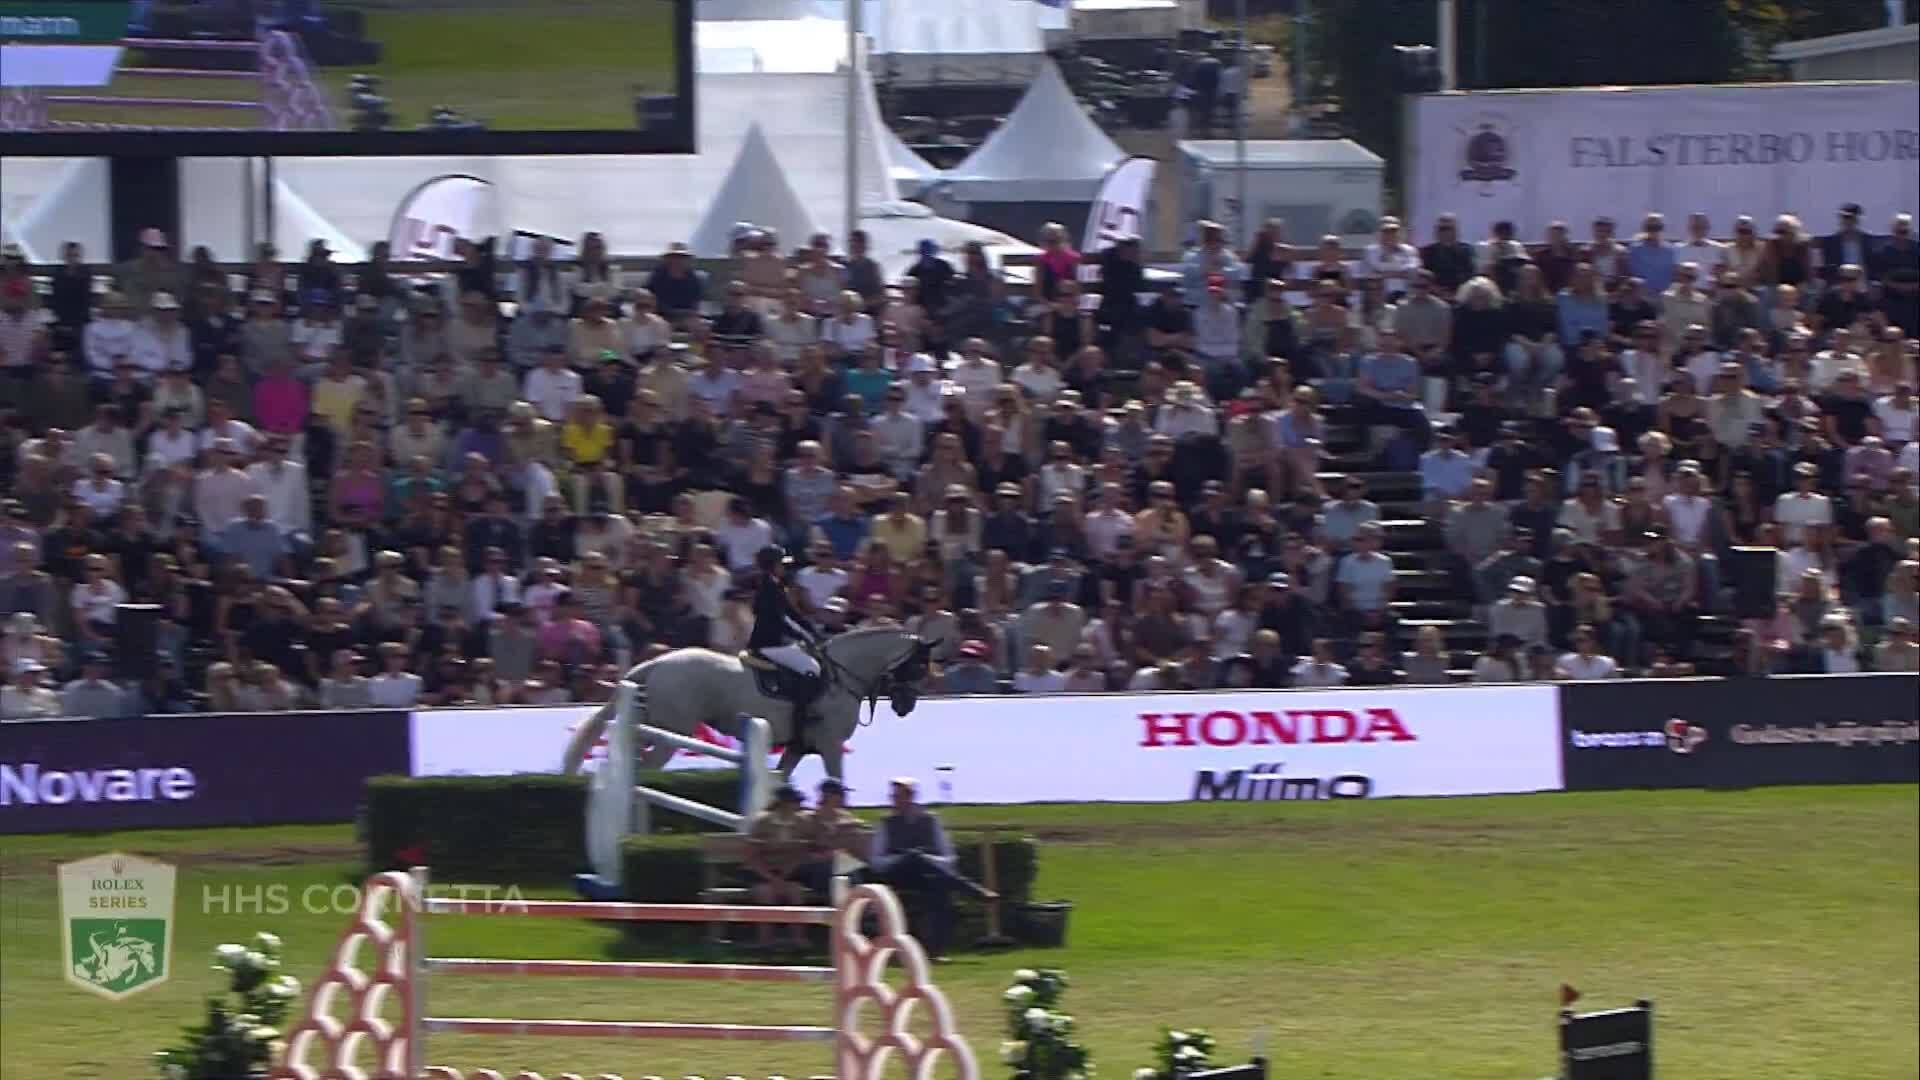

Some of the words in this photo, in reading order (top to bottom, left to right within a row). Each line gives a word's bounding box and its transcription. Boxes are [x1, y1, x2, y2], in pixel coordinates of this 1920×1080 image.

[1568, 131, 1815, 168] FALSTERBO
[1138, 708, 1417, 747] HONDA
[0, 763, 195, 806] Novare
[1191, 762, 1374, 801] Miimo
